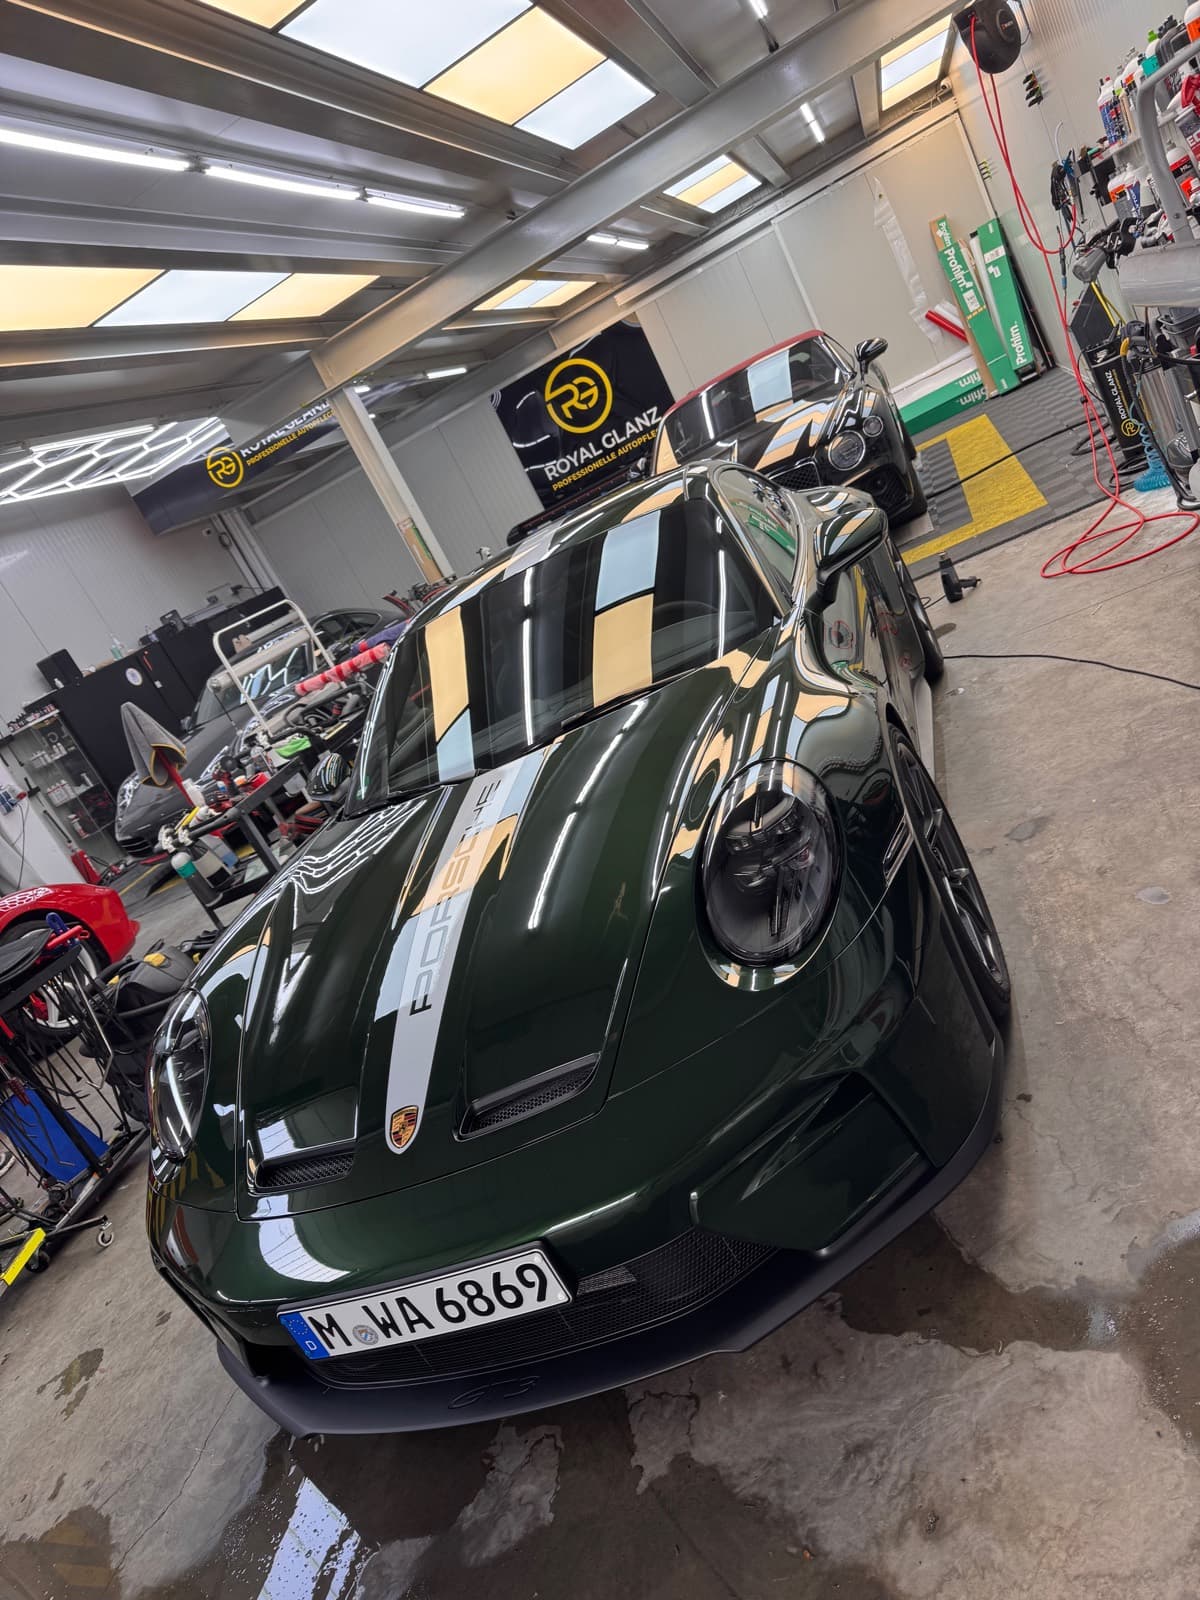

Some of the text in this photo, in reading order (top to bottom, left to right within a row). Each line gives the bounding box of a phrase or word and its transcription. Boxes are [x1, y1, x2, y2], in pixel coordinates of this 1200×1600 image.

[1010, 324, 1027, 365] Profilm
[959, 370, 981, 388] film
[960, 387, 987, 405] ofilm
[1114, 395, 1127, 420] ROYAL
[544, 406, 662, 480] ROYAL GLANZ
[552, 428, 659, 491] PROFESSIONELLE AUTOPFLE
[410, 780, 502, 1016] PORSCHE
[308, 1263, 548, 1350] M WA 6869
[305, 1341, 317, 1350] D
